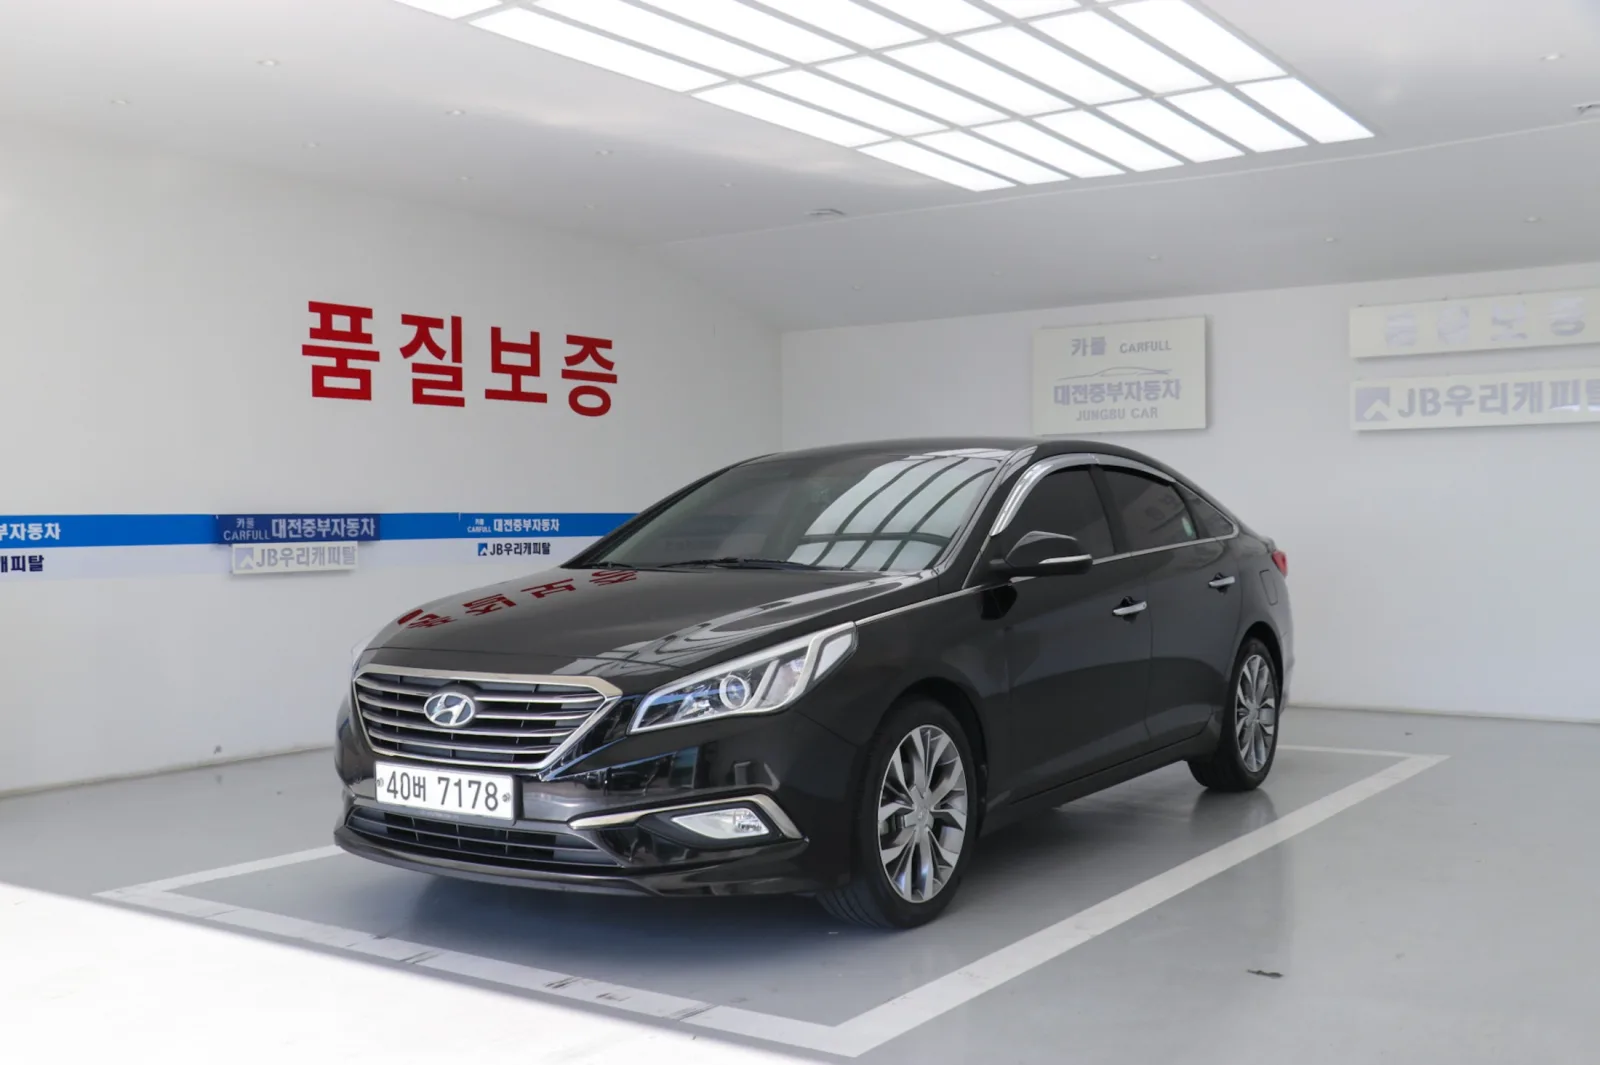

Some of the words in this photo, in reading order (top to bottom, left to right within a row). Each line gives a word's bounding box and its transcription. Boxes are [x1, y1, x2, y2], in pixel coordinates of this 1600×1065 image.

[1119, 340, 1172, 354] CARFULL
[302, 300, 617, 417] 품질보증
[1053, 378, 1182, 406] 대전중부자동차
[1076, 408, 1126, 422] JUNGBU
[1130, 406, 1158, 419] CAR
[271, 518, 375, 539] 대전중부자동차
[493, 518, 560, 532] 대전중부자동차
[223, 529, 270, 541] CARFULL
[256, 546, 356, 568] JB우리캐피탈
[489, 542, 551, 556] JB우리캐피탈
[386, 771, 426, 802] 40버
[437, 776, 499, 811] 7178
